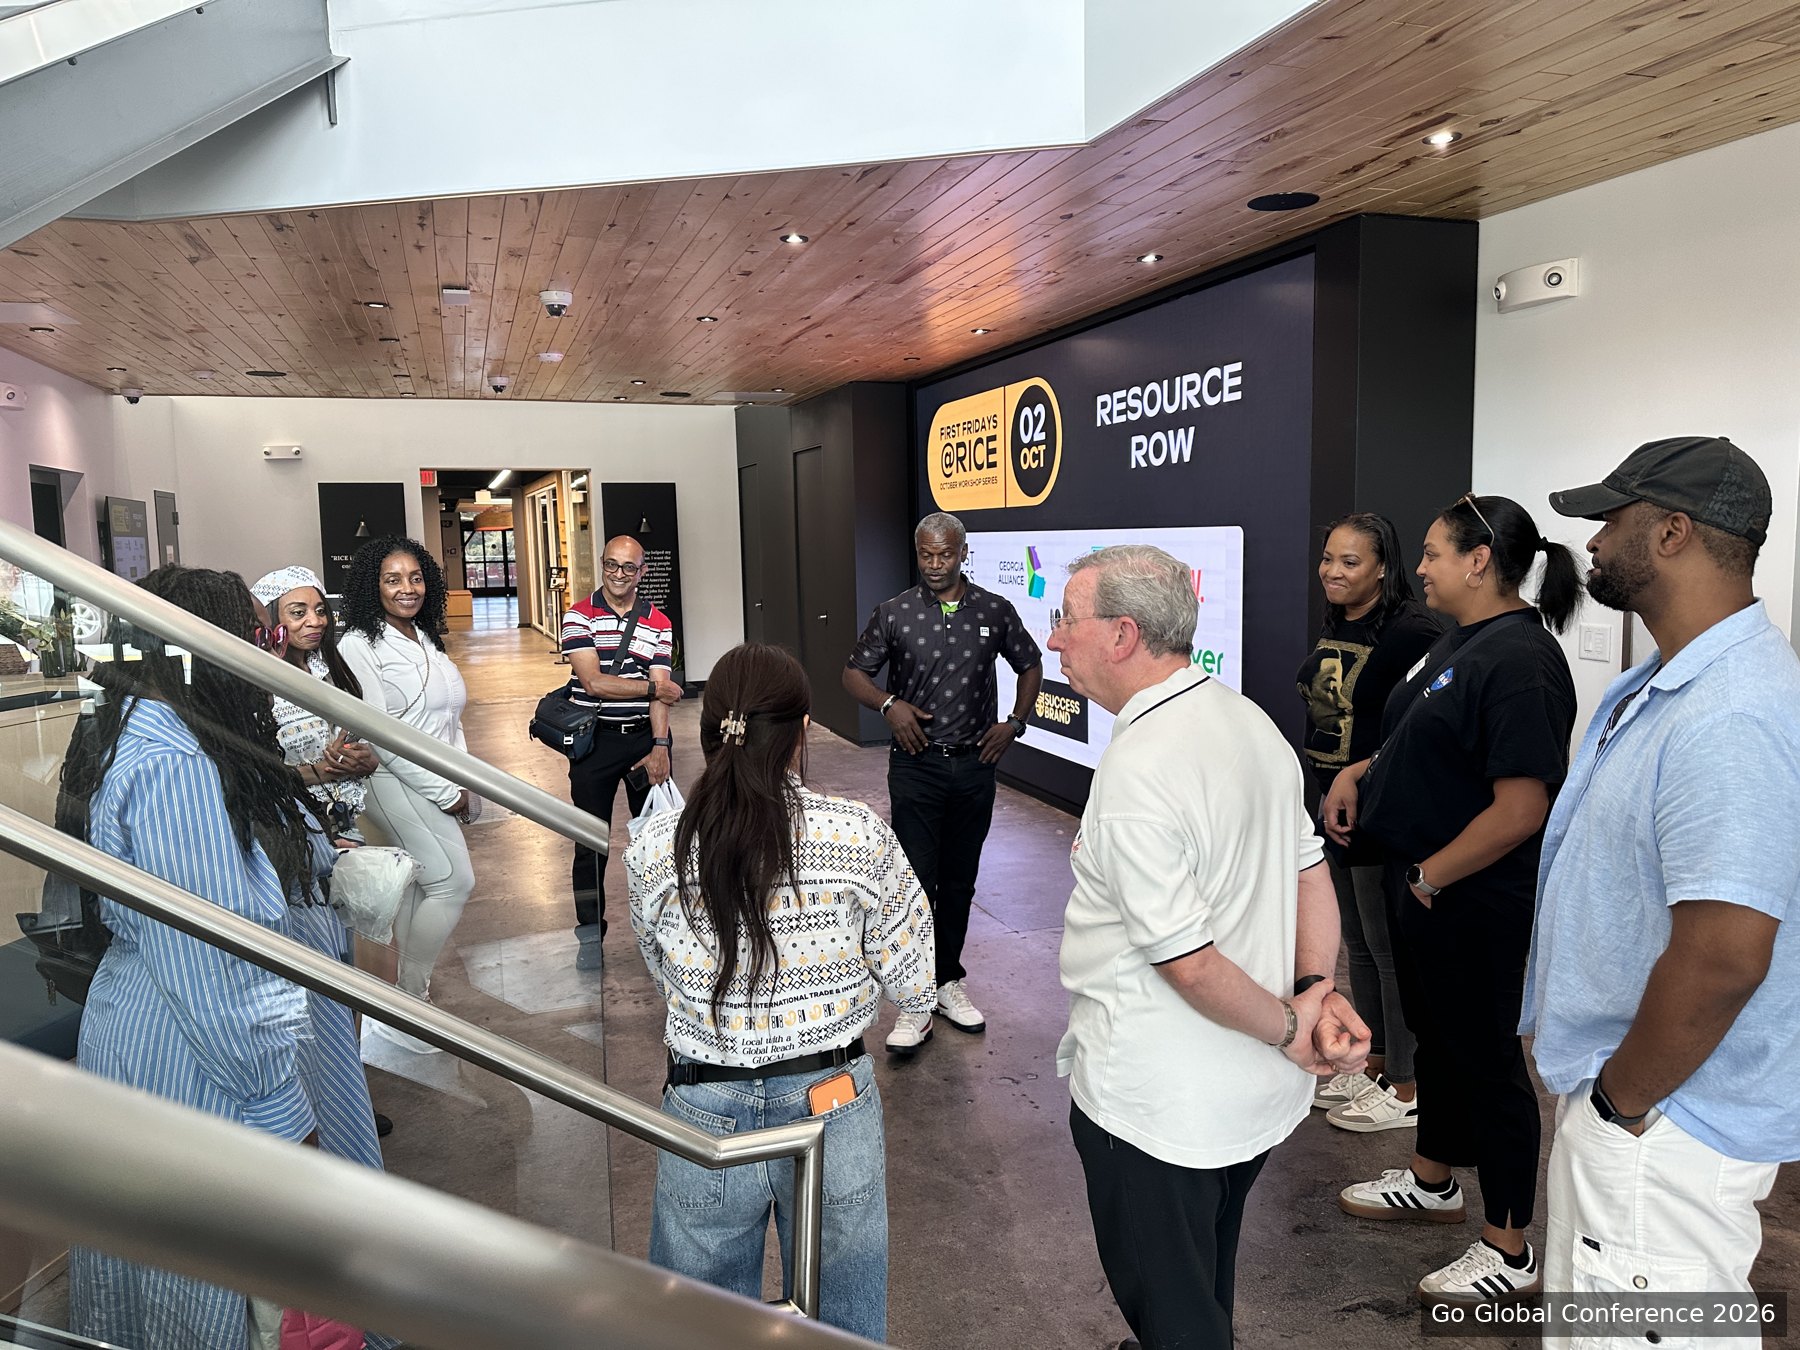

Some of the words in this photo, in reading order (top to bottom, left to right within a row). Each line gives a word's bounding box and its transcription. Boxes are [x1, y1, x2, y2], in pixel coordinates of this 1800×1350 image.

[1096, 361, 1243, 427] RESOURCE
[940, 423, 960, 441] FIRST
[962, 414, 998, 436] FRIDAYS
[1019, 403, 1046, 444] 02
[941, 434, 998, 478] @RICE
[1020, 444, 1046, 470] OCT
[1130, 426, 1196, 469] ROW
[940, 481, 958, 491] OCTOBER
[958, 478, 982, 489] WORKSHOP
[982, 475, 998, 486] SERIES
[999, 561, 1025, 571] GEORGIA
[998, 574, 1025, 586] ALLIANCE
[1044, 692, 1081, 715] SUCCESS
[1044, 705, 1071, 725] BRAND
[825, 878, 868, 892] INVESTMENT
[753, 993, 809, 1008] INTERNATIONAL
[809, 987, 835, 999] TRADE
[741, 1037, 763, 1046] Local
[765, 1034, 784, 1044] with
[742, 1046, 769, 1055] Global
[770, 1042, 795, 1053] Reach
